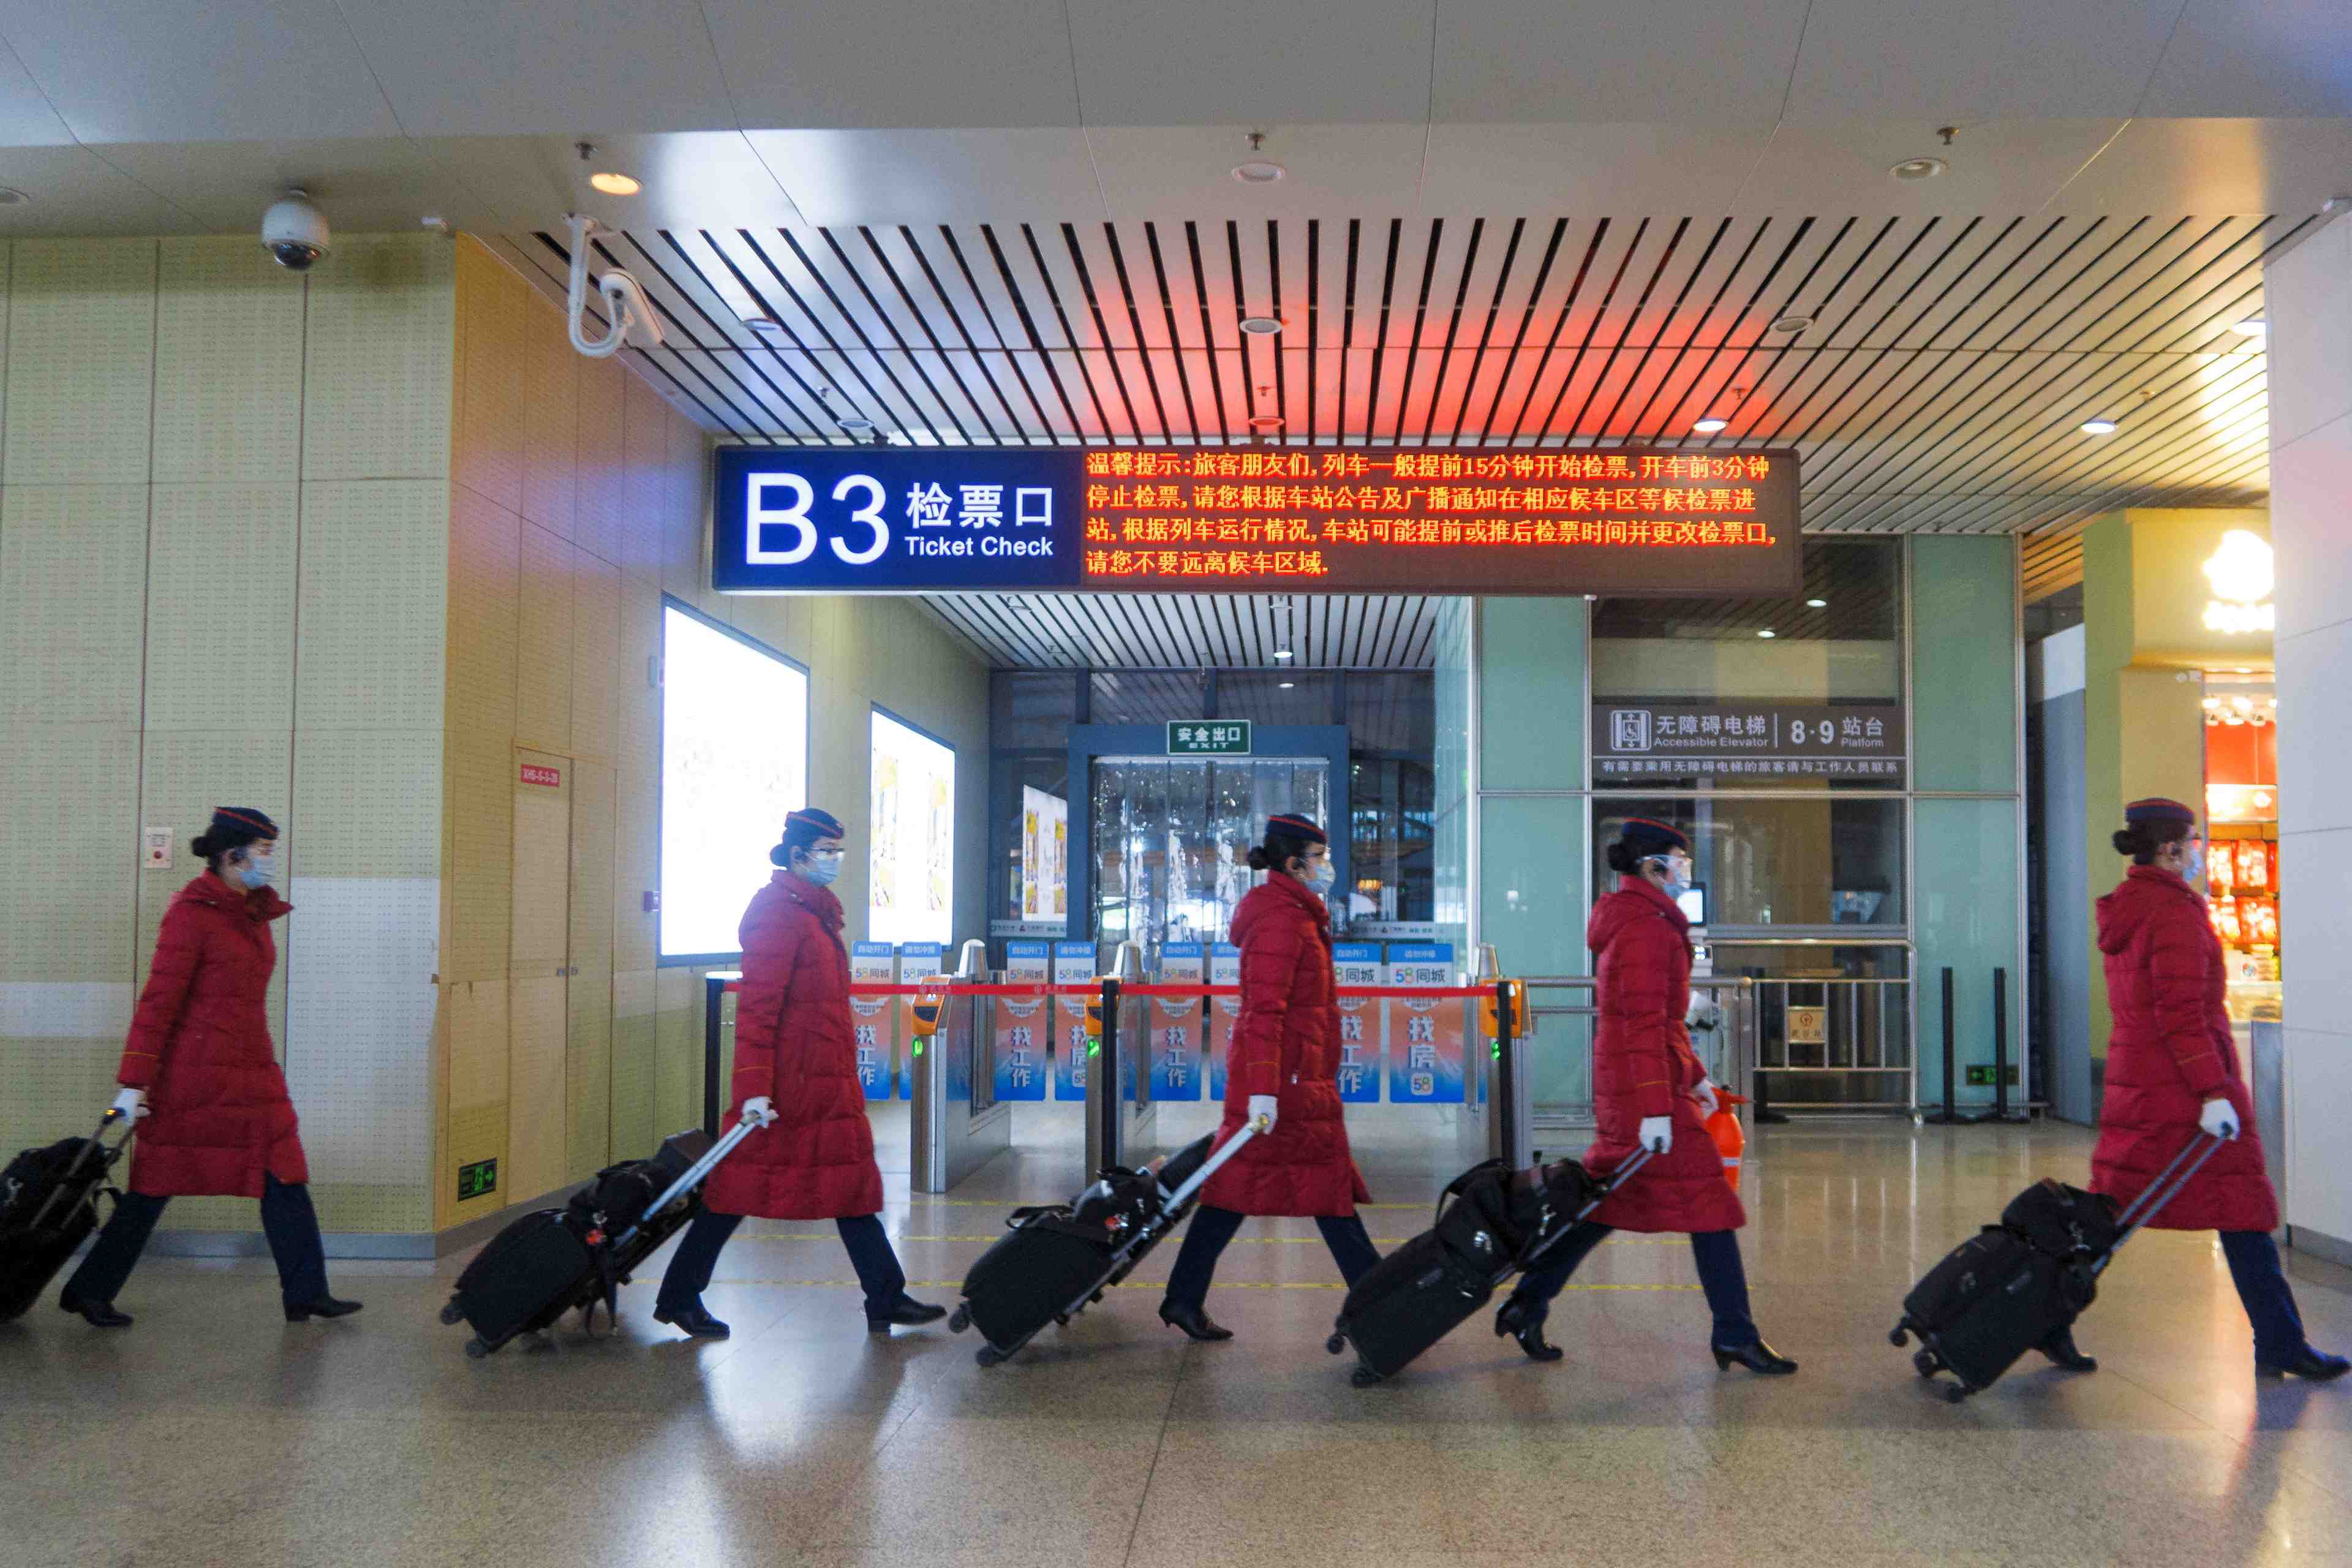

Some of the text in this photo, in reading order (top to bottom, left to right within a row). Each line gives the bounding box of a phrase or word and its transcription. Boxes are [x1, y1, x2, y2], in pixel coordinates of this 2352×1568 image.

[905, 481, 1053, 529] 检票口
[745, 472, 890, 566] B3
[905, 536, 1054, 556] Ticket Check
[1177, 727, 1241, 742] 安全出口
[1656, 715, 1766, 736] 无障碍电梯
[1842, 717, 1884, 736] 站台
[1654, 737, 1770, 748] Accessible Elevator
[1841, 737, 1884, 748] Platform
[1395, 967, 1446, 984] 58同城
[1408, 1016, 1435, 1069] 找房
[1011, 1025, 1032, 1088] 找工作
[1412, 1076, 1431, 1091] 58
